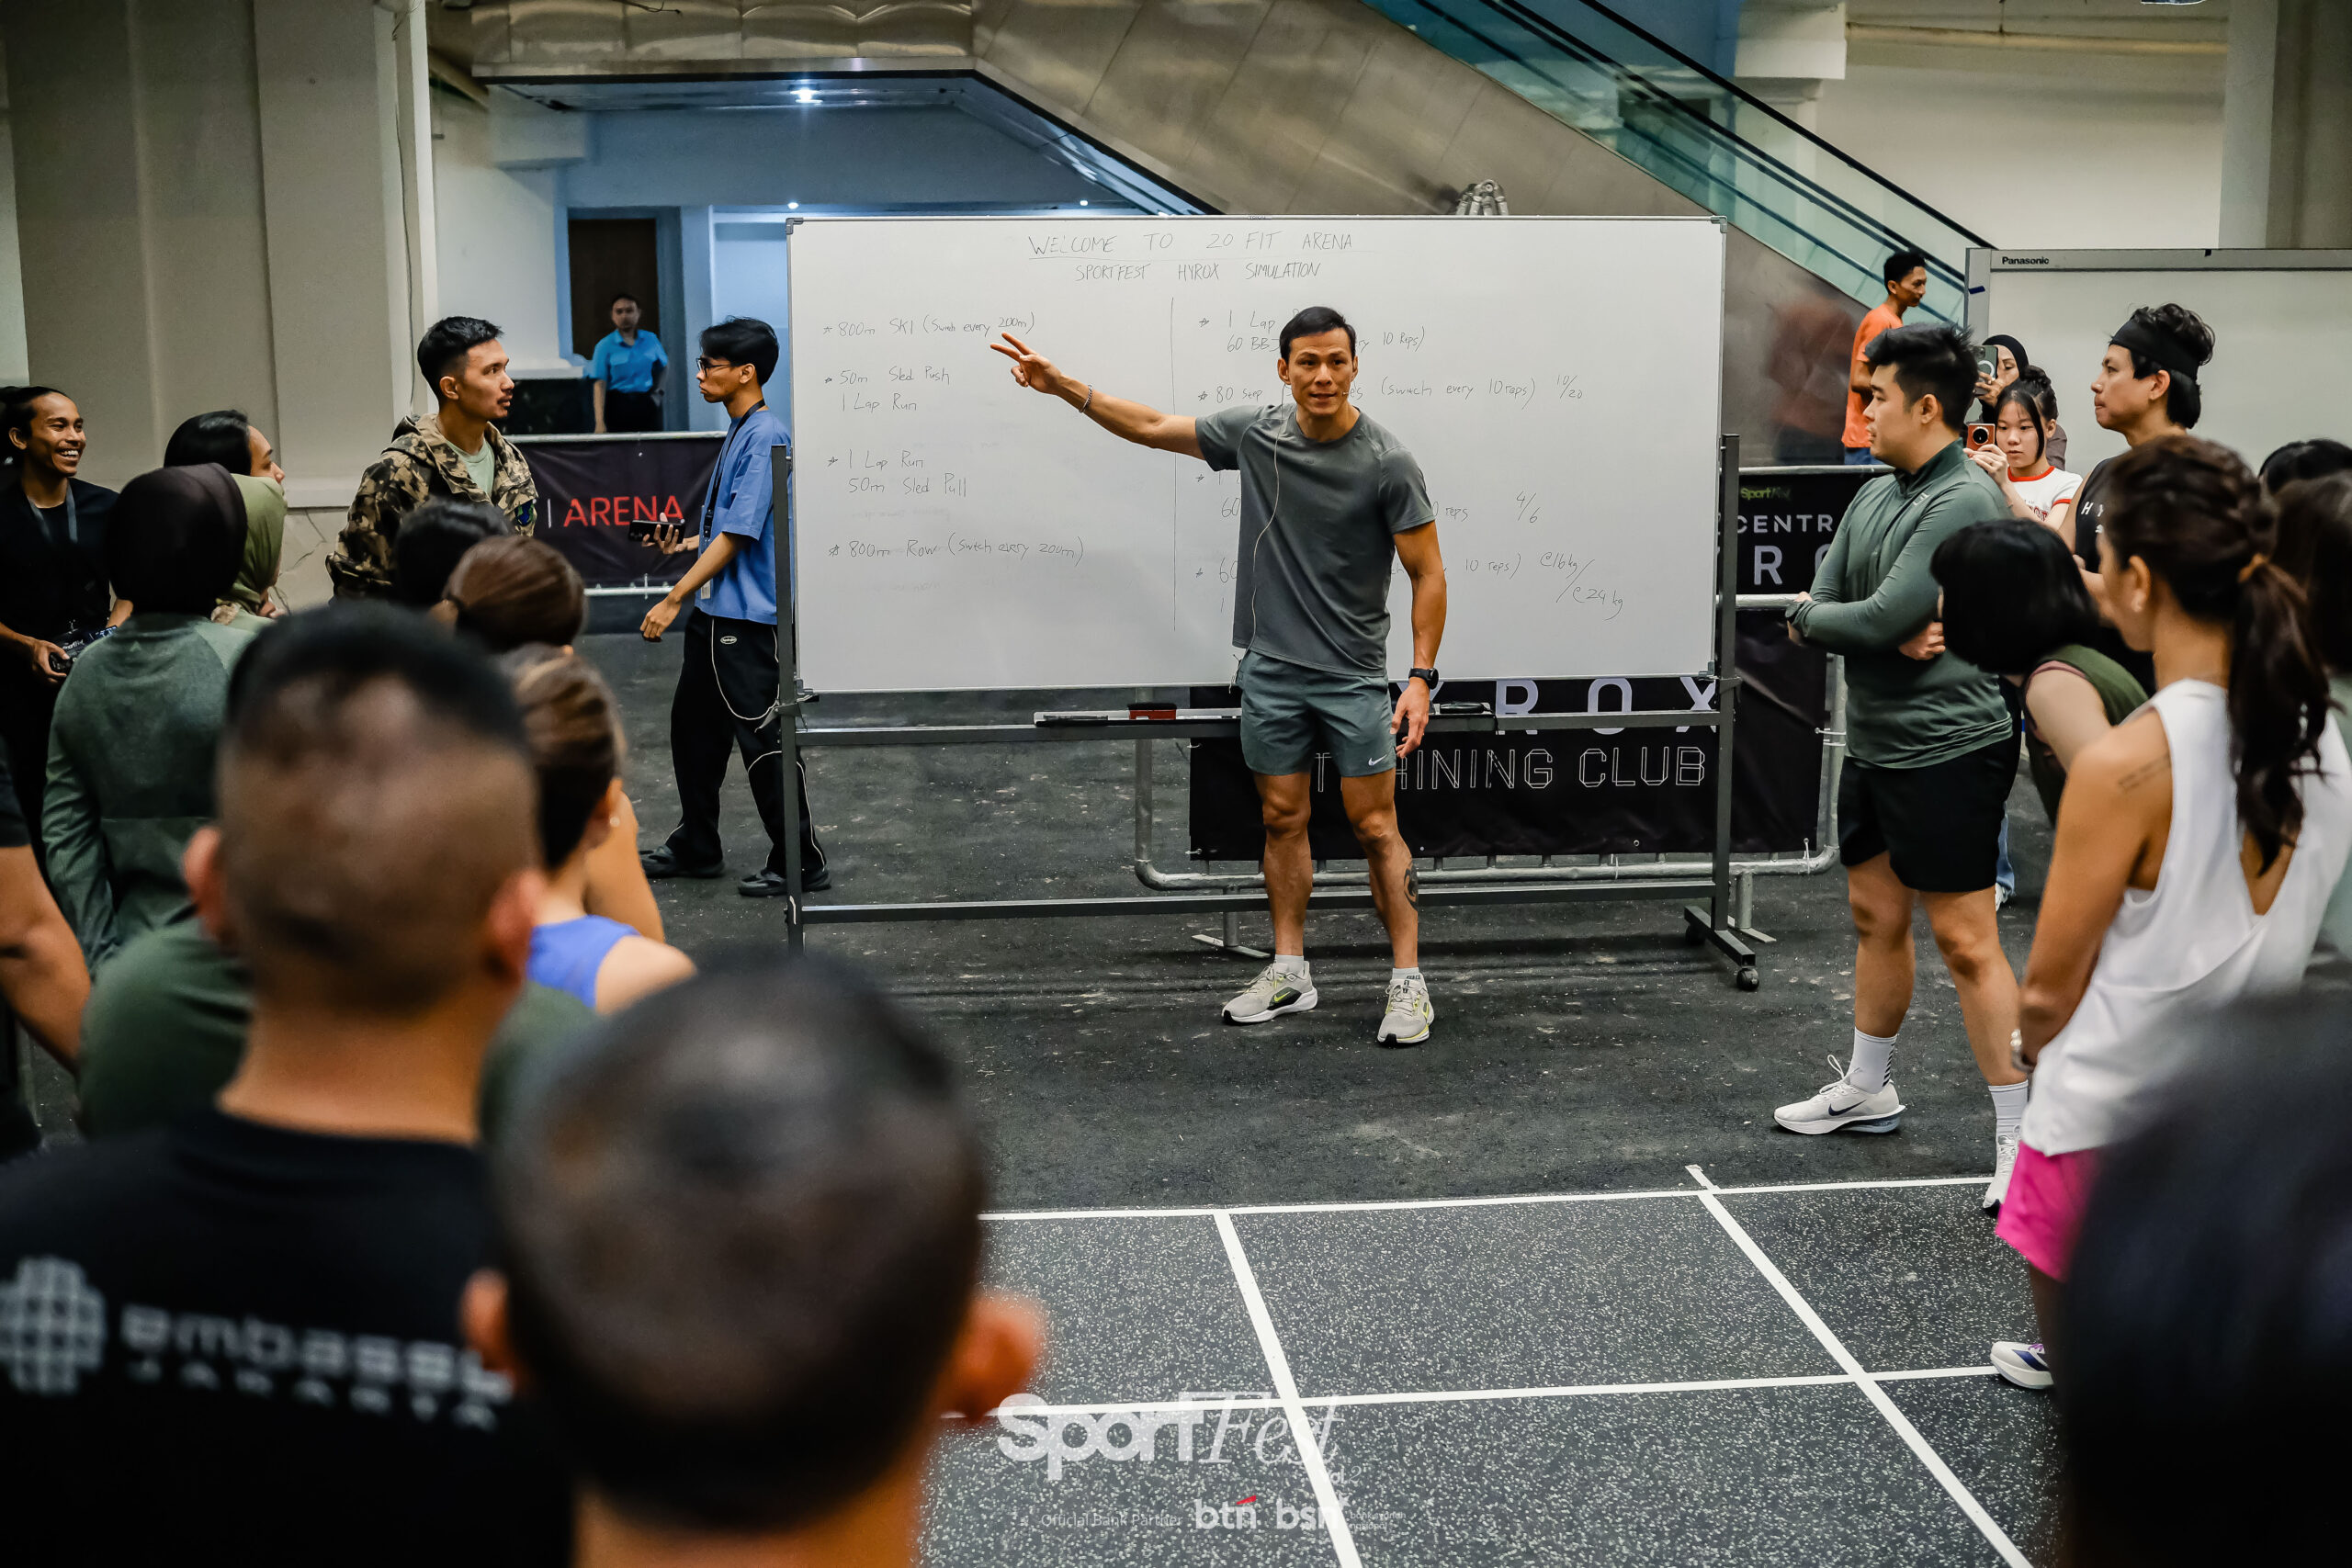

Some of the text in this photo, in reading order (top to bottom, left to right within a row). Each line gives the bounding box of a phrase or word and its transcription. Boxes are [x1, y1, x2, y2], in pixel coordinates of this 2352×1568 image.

[1028, 231, 1353, 255] WELCOME TO 20 FIT ARENA
[2001, 255, 2050, 265] Panasonic
[1075, 261, 1322, 282] SPORTFEST HYROX SIMULATION
[838, 321, 876, 337] 800m
[888, 317, 914, 335] SKI
[963, 322, 990, 338] every
[997, 311, 1035, 336] 200m)
[1228, 309, 1276, 334] 1 Lap
[1227, 333, 1243, 353] 60
[1383, 331, 1394, 346] 10
[839, 365, 951, 387] 50m Sled Push
[1216, 385, 1234, 404] 80
[1445, 384, 1475, 400] every
[1488, 378, 1503, 395] 10
[842, 392, 917, 412] 1 Lap Run
[848, 448, 924, 471] 1 Lap Run
[847, 471, 967, 498] 50m Sled Pull
[563, 494, 684, 527] ARENA
[1221, 496, 1240, 518] 60
[1736, 513, 1834, 534] CENTR
[848, 539, 891, 558] 800m
[905, 538, 938, 558] Row
[998, 542, 1030, 561] every
[1219, 557, 1238, 583] 60
[1465, 558, 1479, 572] 10
[1315, 745, 1707, 793] TINING CLUB
